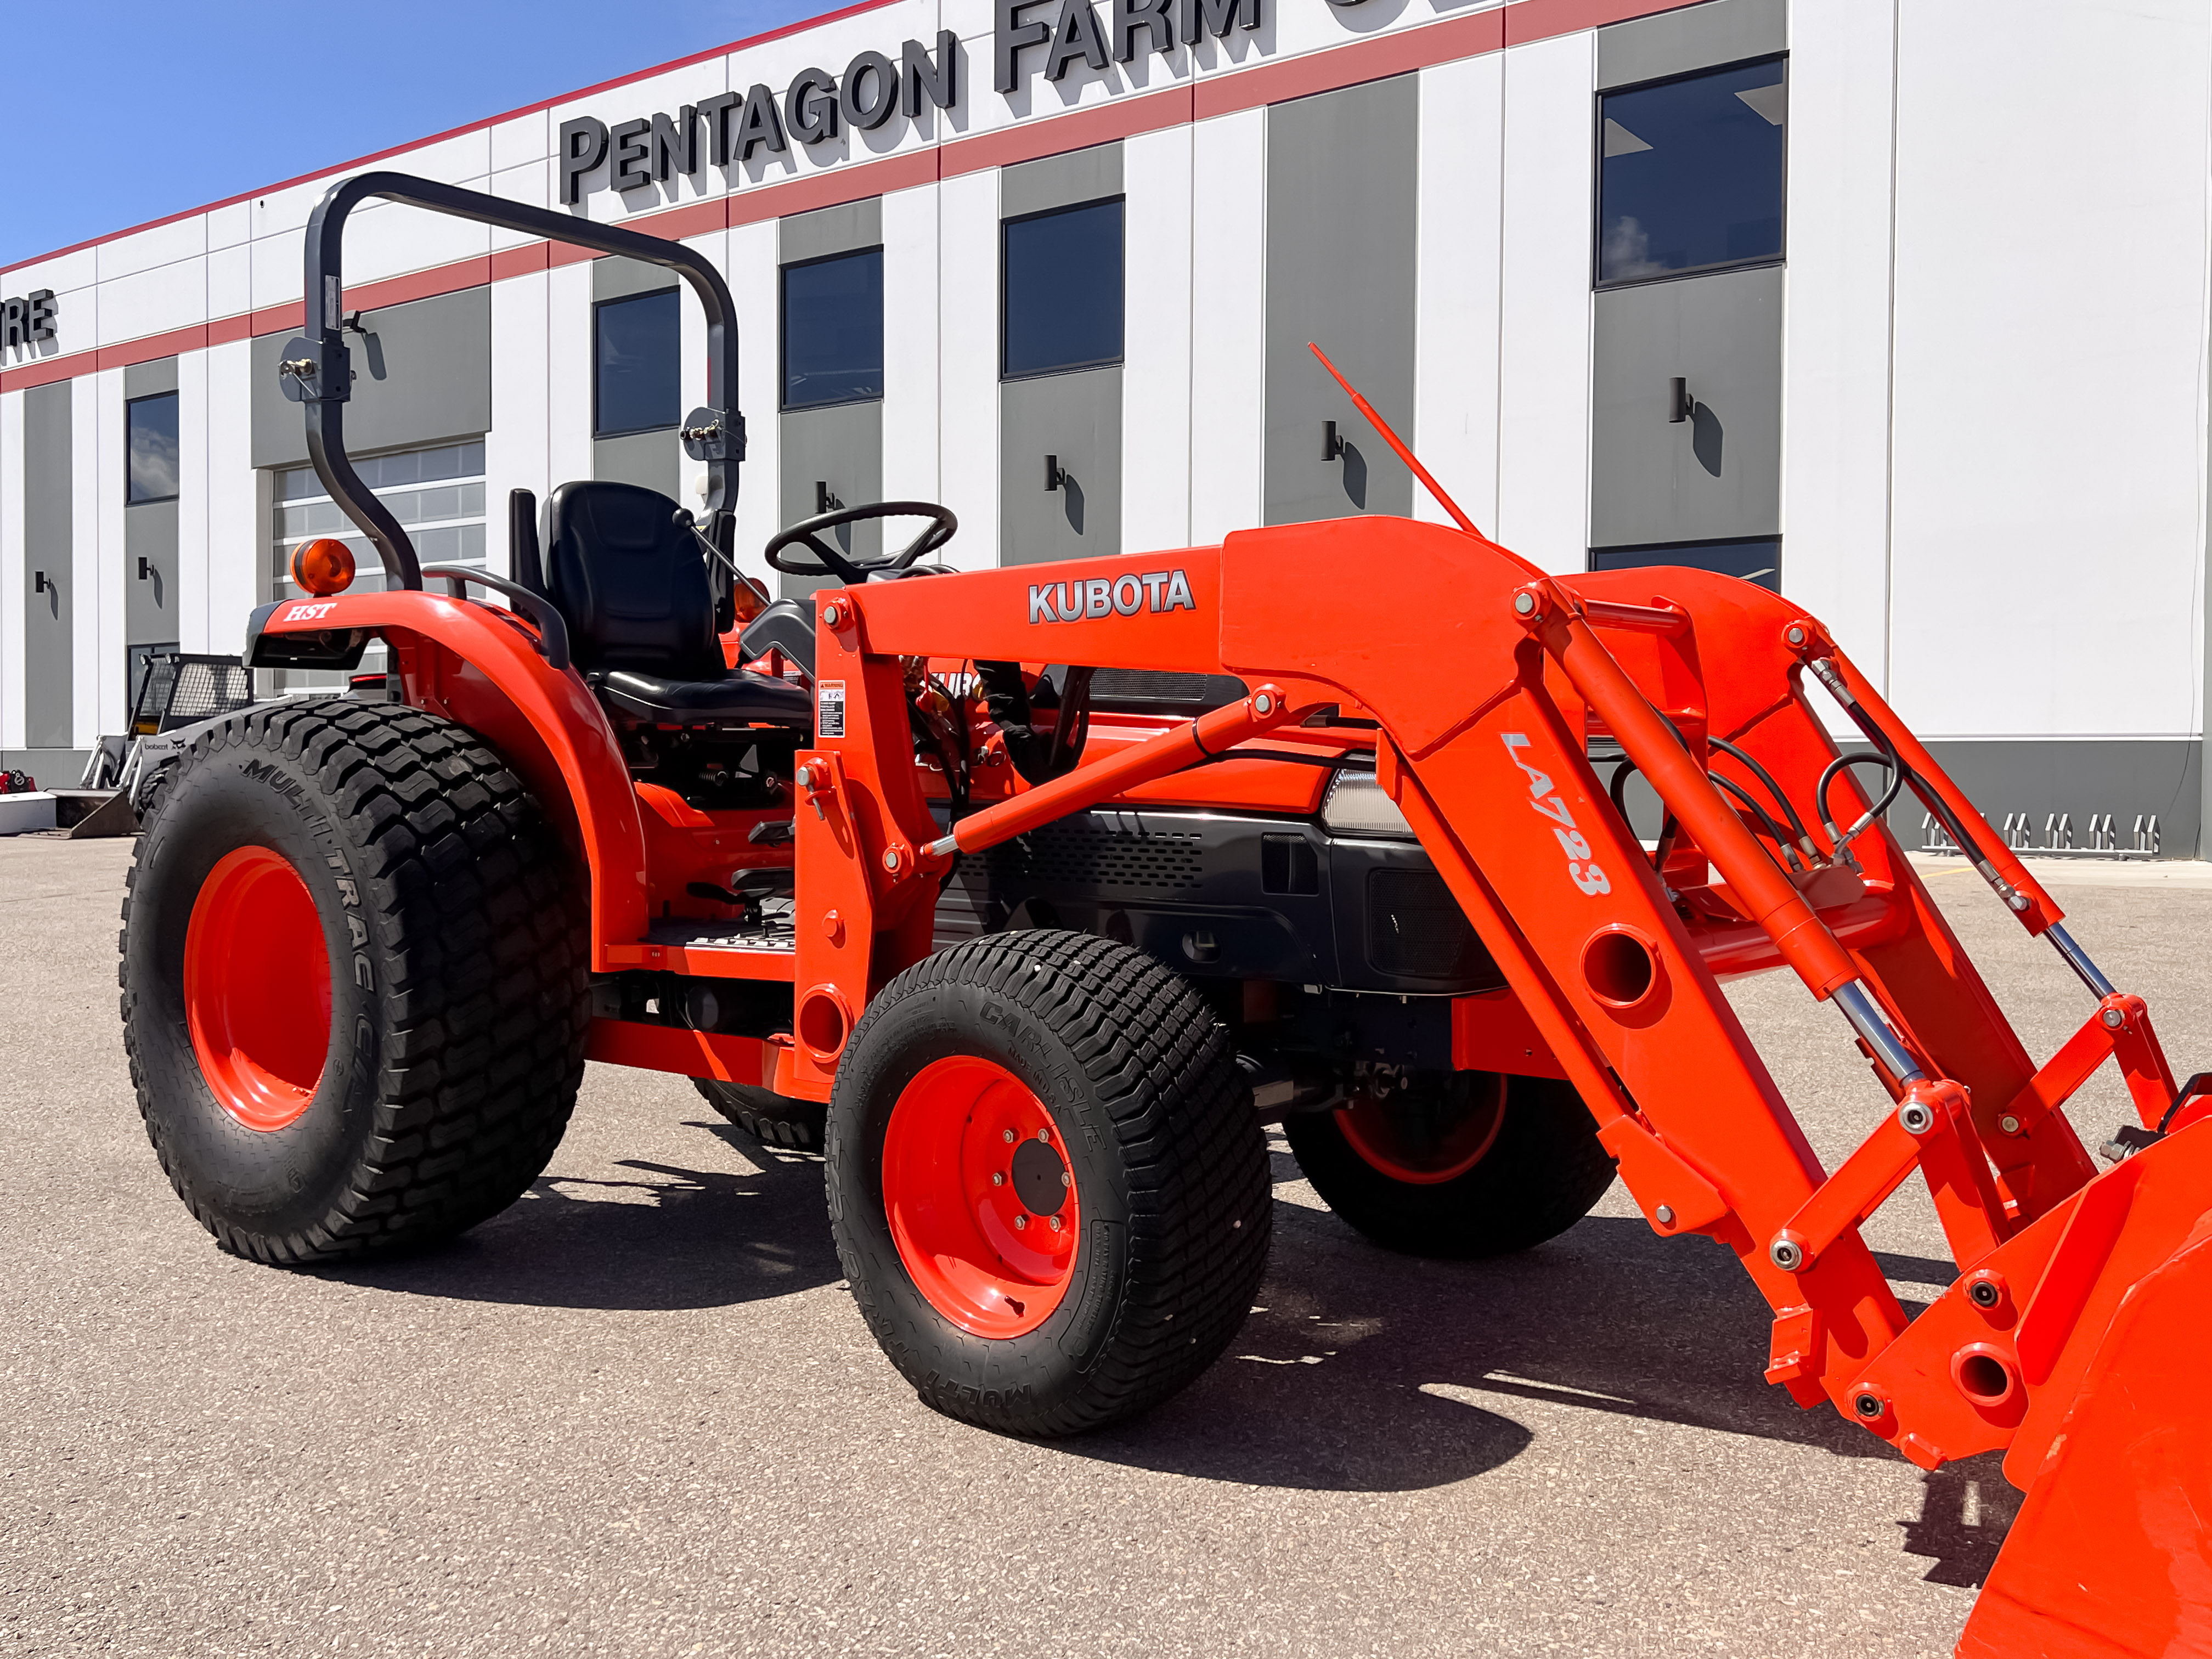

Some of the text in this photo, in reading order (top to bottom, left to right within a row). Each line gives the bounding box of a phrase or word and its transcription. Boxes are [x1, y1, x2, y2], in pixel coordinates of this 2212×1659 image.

[560, 29, 956, 205] PENTAGON
[0, 289, 54, 351] RE
[283, 602, 338, 622] HST
[1029, 569, 1197, 624] KUBOTA
[1500, 733, 1611, 896] LA723
[325, 845, 375, 992] TRAC
[980, 1001, 1108, 1152] CARLISLE
[1008, 1046, 1033, 1073] MADE
[926, 1368, 1031, 1408] MULTI
